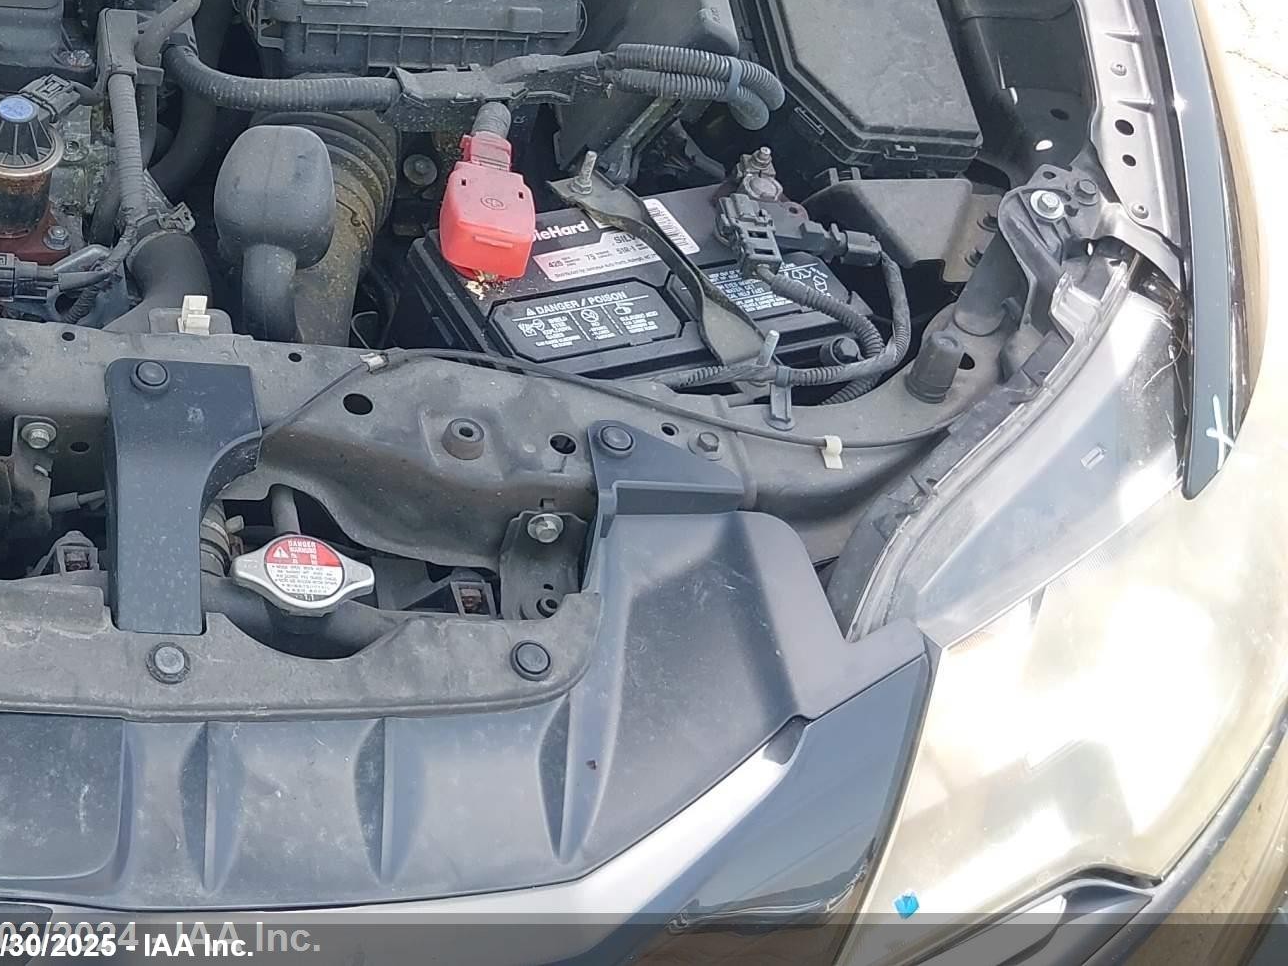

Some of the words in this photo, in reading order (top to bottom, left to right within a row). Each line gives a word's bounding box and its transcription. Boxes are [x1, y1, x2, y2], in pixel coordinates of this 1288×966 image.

[535, 300, 580, 315] DANGER
[587, 291, 627, 305] POISON
[287, 539, 316, 548] DANGER
